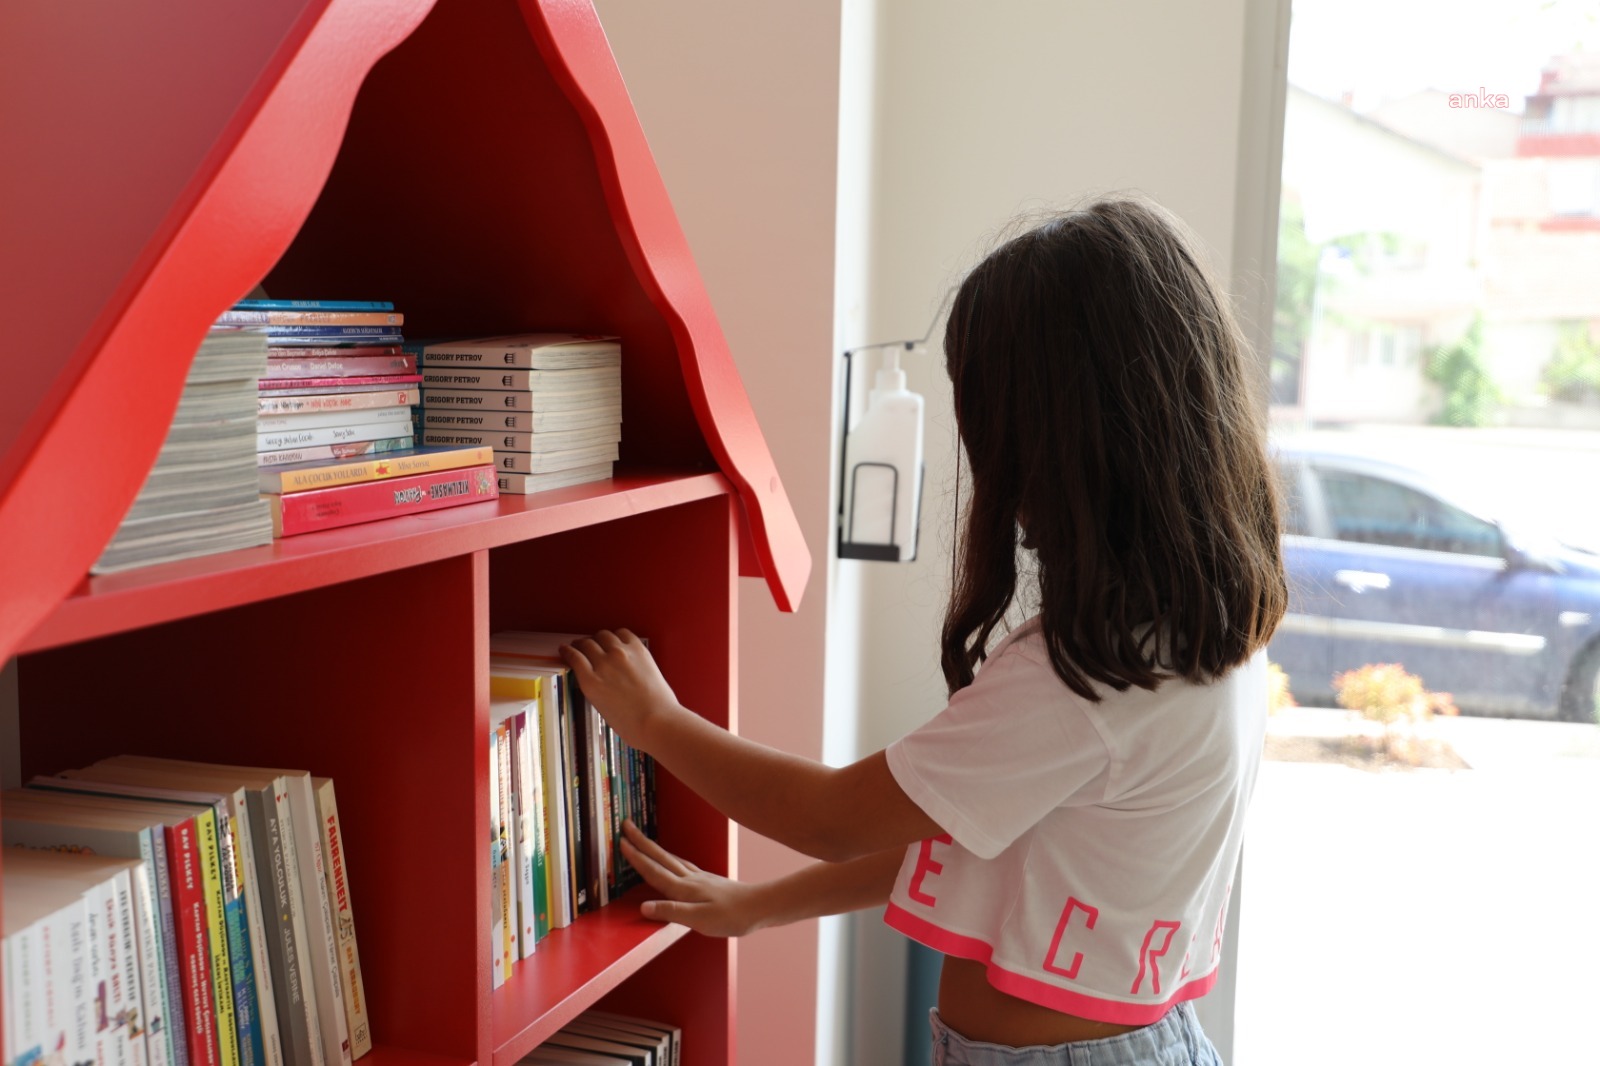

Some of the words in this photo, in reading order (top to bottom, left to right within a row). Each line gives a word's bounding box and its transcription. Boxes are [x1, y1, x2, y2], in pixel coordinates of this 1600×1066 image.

[310, 362, 327, 371] Daniel
[327, 362, 343, 370] Defoe
[425, 353, 454, 361] GRIGORY
[455, 354, 482, 362] PETROV
[424, 375, 453, 383] GRIGORY
[453, 376, 480, 384] PETROV
[425, 396, 455, 404] GRIGORY
[456, 397, 483, 405] PETROV
[426, 416, 455, 424] GRIGORY
[456, 417, 483, 425] PETROV
[425, 435, 454, 443] GRIGORY
[455, 436, 482, 444] PETROV
[293, 475, 307, 486] ALA
[307, 472, 333, 485] ÇOCUK
[333, 467, 368, 483] YOLLARDA
[431, 480, 470, 499] KIZILMASKE
[181, 828, 190, 850] DAV
[270, 818, 279, 846] AY'A
[184, 852, 194, 890] PILKEY
[208, 844, 217, 881] PILKEY
[327, 815, 348, 913] FAHRENHEIT
[274, 846, 288, 908] YOLCULUK
[193, 901, 201, 932] KAPTAN
[284, 927, 294, 963] JULES
[288, 963, 300, 1004] VERNE
[349, 968, 360, 1015] BRADBURY
